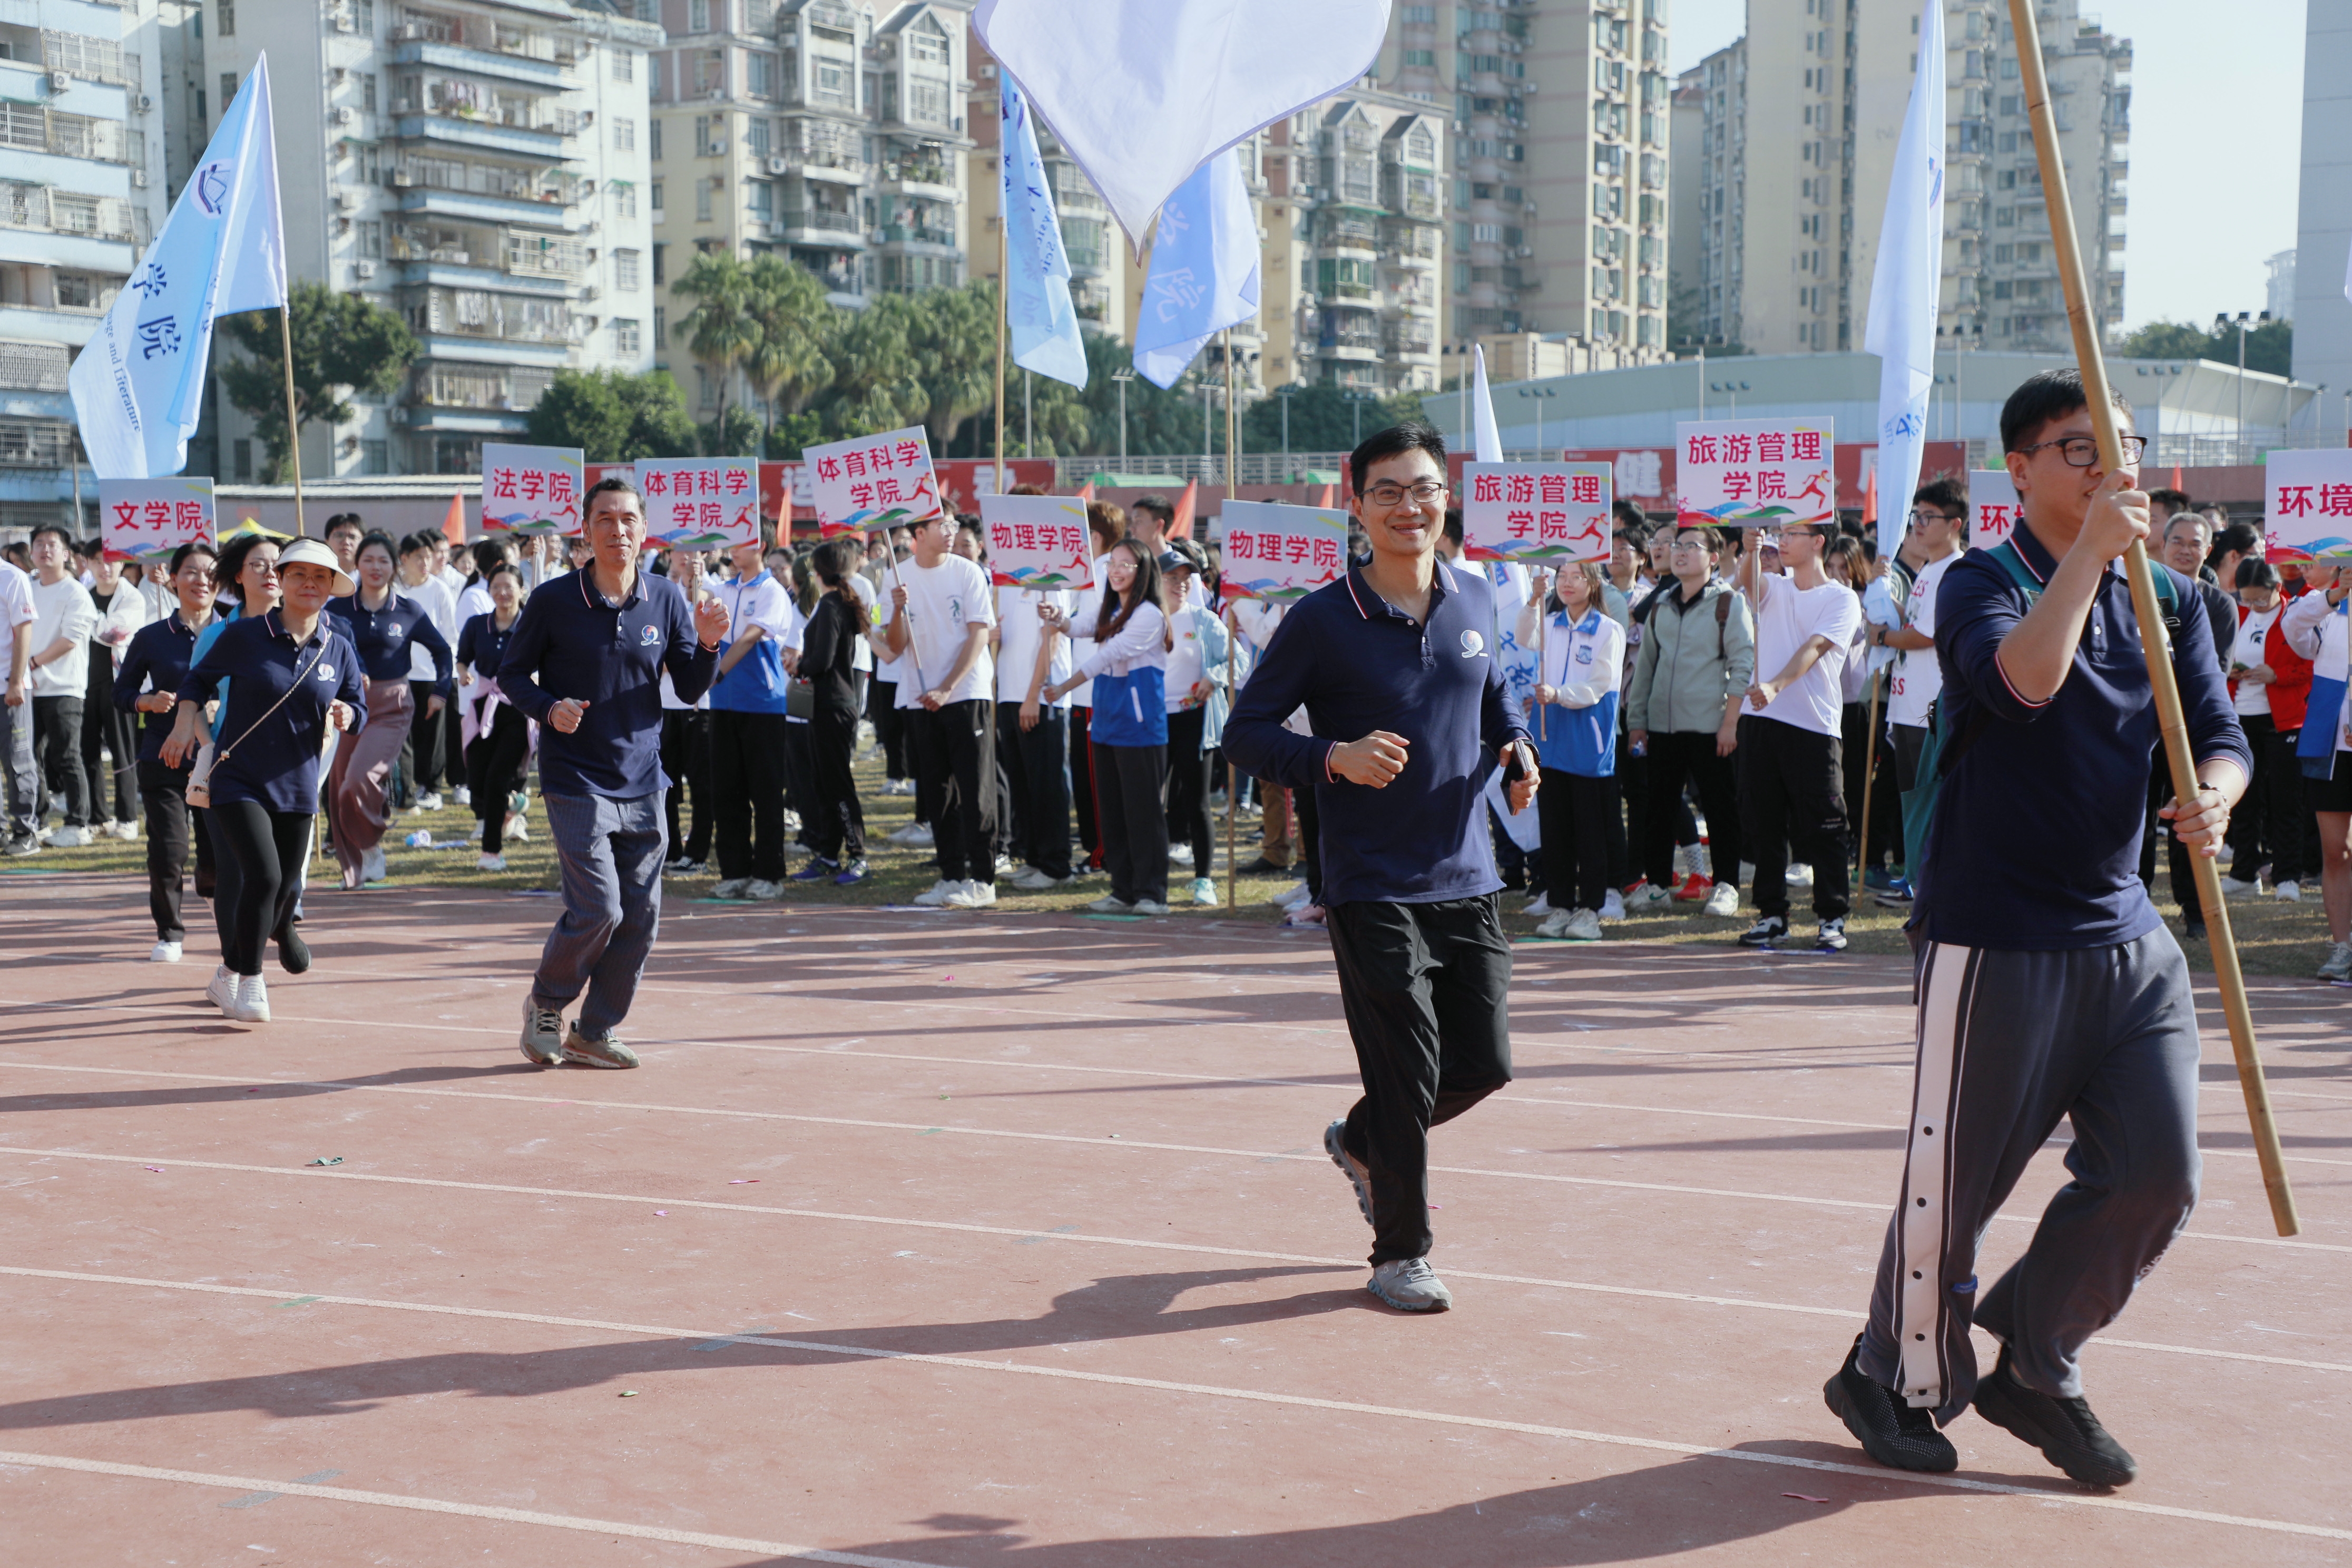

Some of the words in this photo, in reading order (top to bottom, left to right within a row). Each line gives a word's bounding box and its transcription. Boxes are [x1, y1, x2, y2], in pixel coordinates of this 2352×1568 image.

[109, 342, 122, 366] and
[113, 368, 141, 433] Literature
[817, 440, 921, 484] 体育科学
[1688, 432, 1821, 465] 旅游管理
[494, 467, 572, 504] 法学院
[644, 469, 748, 497] 体育科学
[1474, 474, 1601, 504] 旅游管理
[1614, 450, 1662, 498] 健
[1723, 470, 1787, 501] 学院
[849, 476, 902, 509] 学院
[2278, 483, 2352, 518] 环境
[112, 501, 203, 531] 文学院
[672, 502, 722, 528] 学院
[1507, 510, 1567, 540] 学院
[1980, 504, 2024, 535] 环
[991, 522, 1083, 554] 物理学院
[1229, 529, 1338, 569] 物理学院
